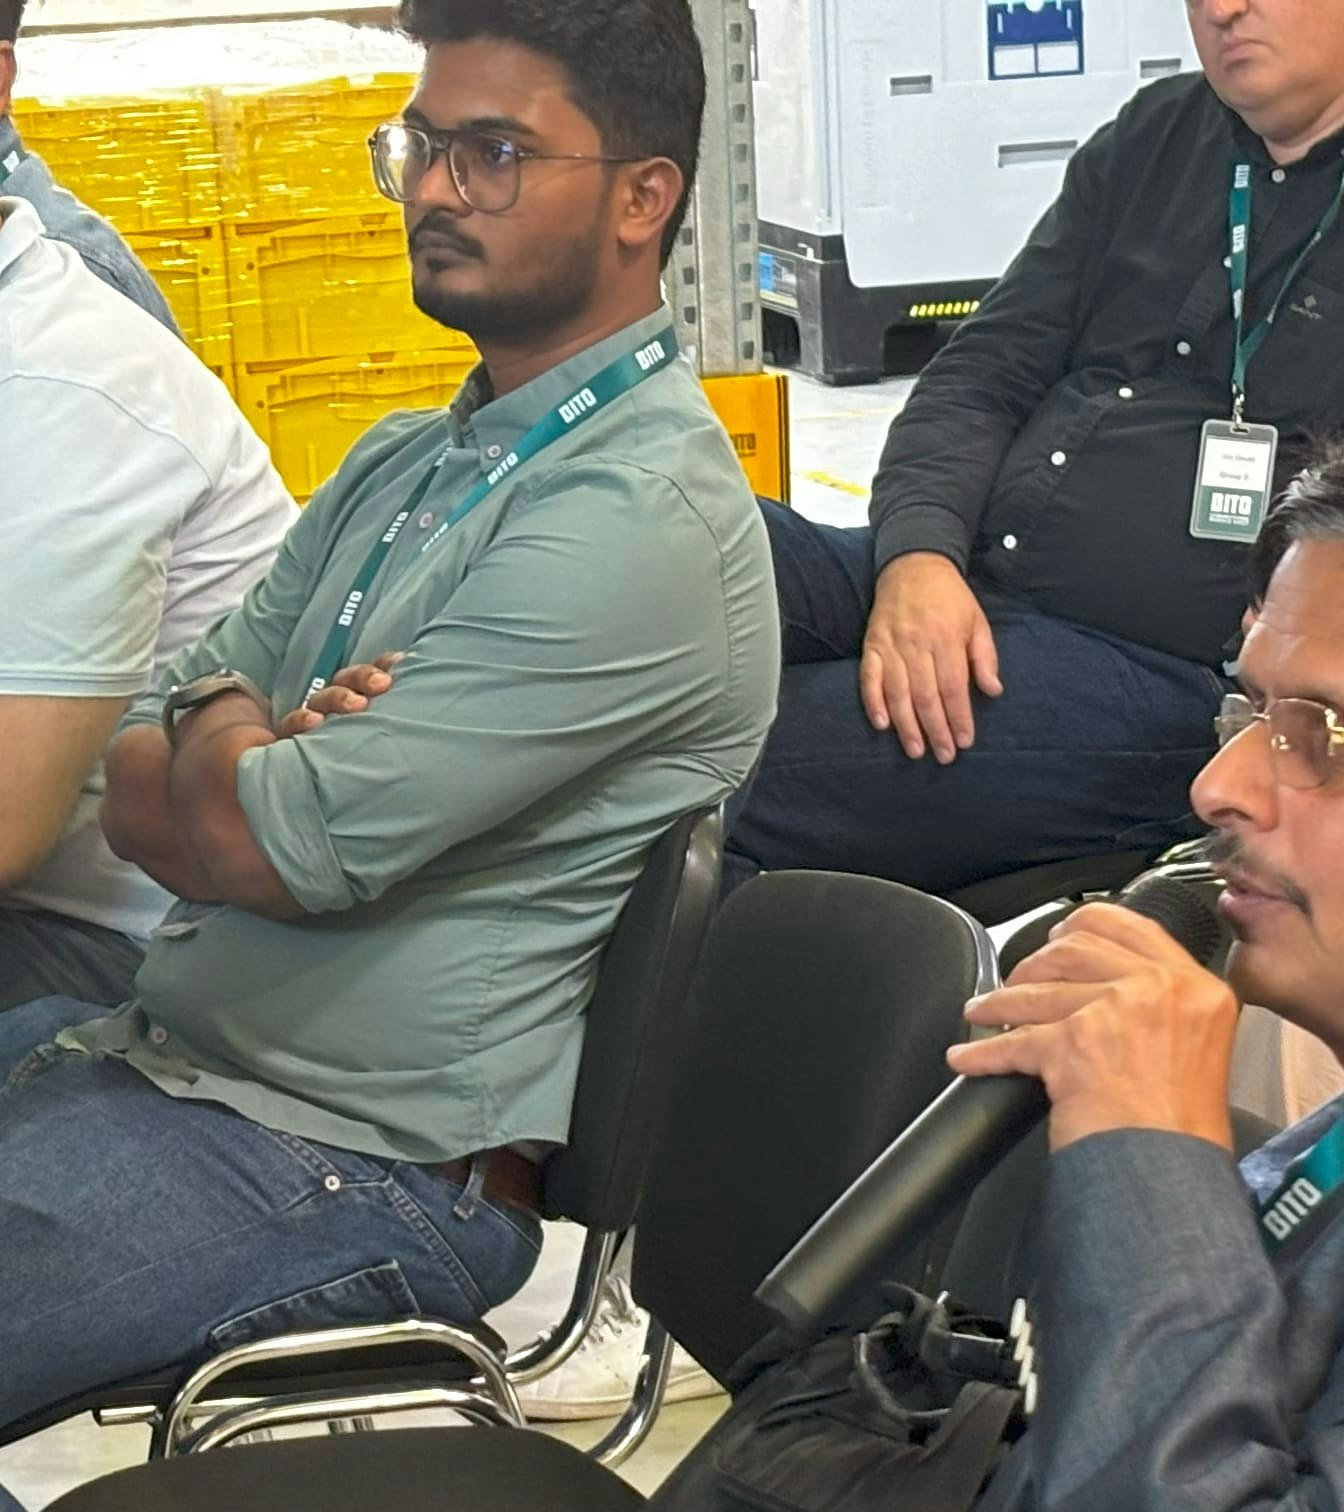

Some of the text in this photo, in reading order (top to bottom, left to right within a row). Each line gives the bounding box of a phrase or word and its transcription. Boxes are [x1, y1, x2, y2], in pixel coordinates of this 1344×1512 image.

[634, 340, 666, 371] BITO
[558, 387, 598, 424] BITO
[487, 452, 519, 486] BITO
[1210, 492, 1252, 515] BITO
[382, 511, 409, 543] BITO
[338, 590, 363, 627] BITO
[1262, 1177, 1323, 1241] BITO
